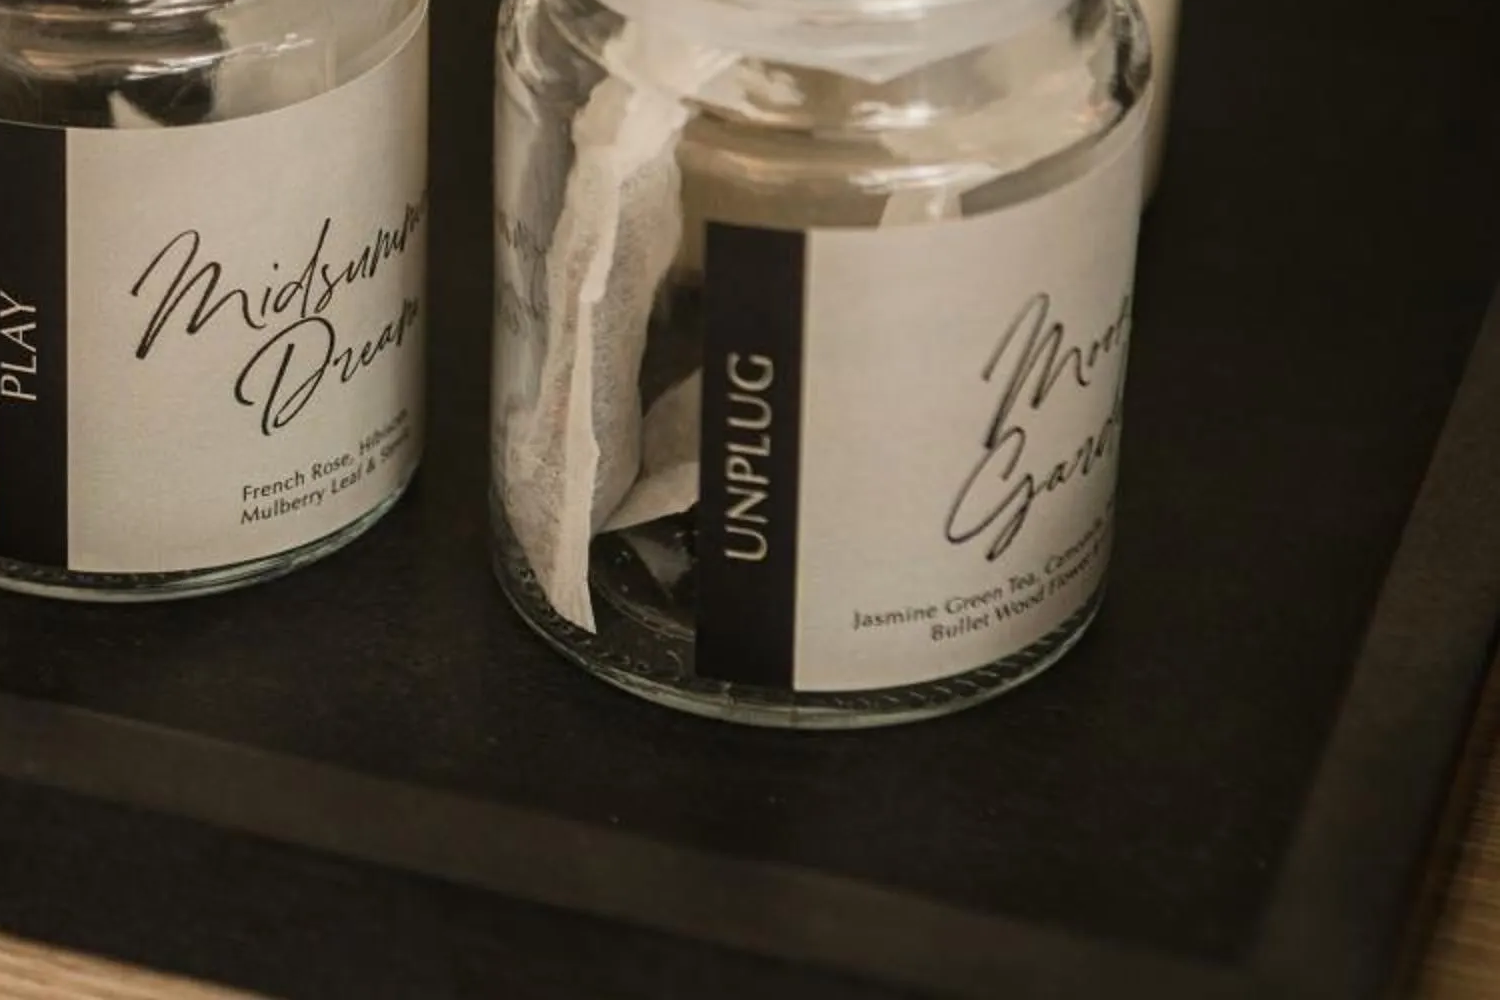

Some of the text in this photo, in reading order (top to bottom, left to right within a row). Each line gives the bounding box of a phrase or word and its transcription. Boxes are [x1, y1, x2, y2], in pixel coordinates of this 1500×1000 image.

[0, 290, 38, 401] PLAY
[724, 352, 774, 561] UNPLUG
[241, 488, 325, 524] Mulberry
[331, 463, 362, 494] Leaf
[243, 472, 305, 501] French
[853, 605, 937, 630] Jasmine
[944, 587, 1003, 614] Green
[930, 612, 990, 642] Bullet
[995, 584, 1044, 622] Wood
